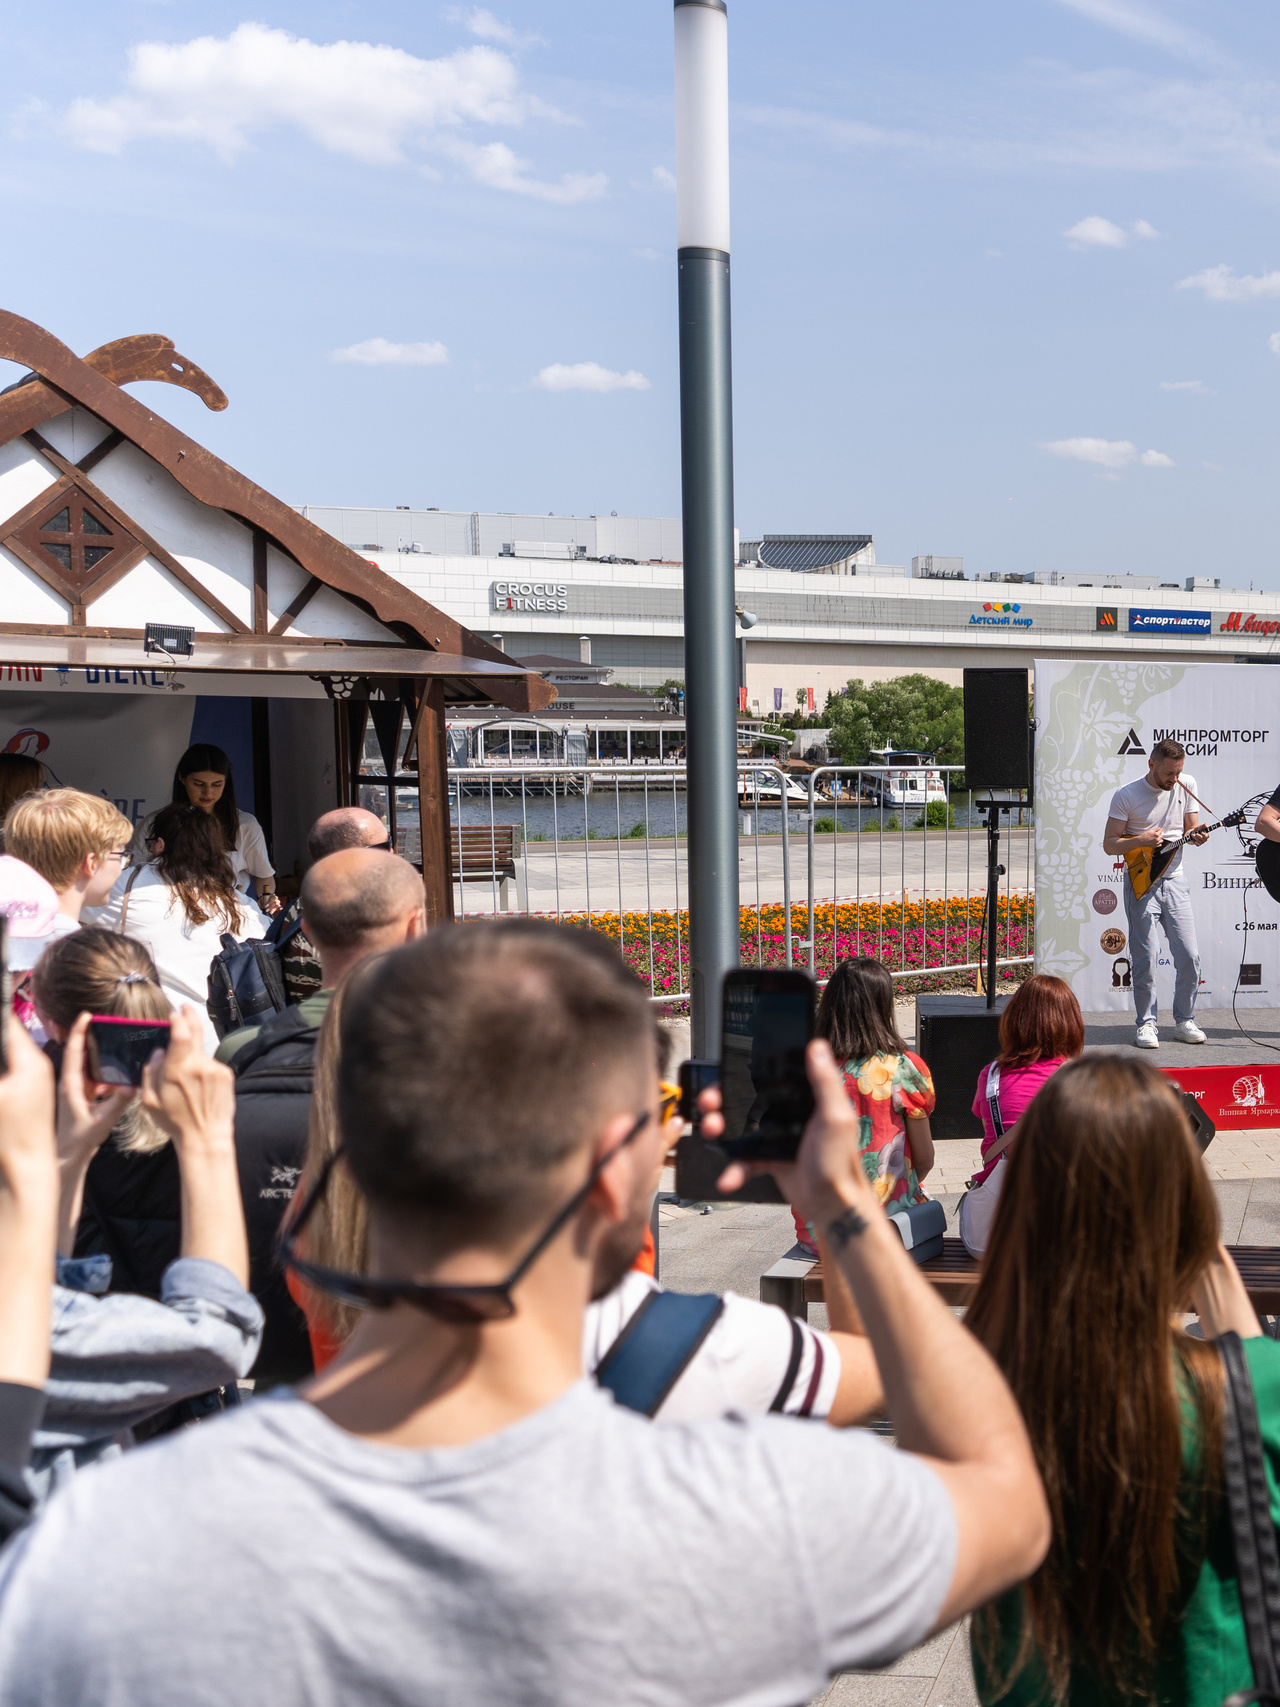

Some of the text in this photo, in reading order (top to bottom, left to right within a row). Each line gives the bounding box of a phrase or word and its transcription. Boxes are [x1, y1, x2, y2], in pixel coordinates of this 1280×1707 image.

[495, 582, 568, 597] CROCUS
[969, 614, 1033, 628] Детский мир
[1143, 616, 1211, 627] спортмастер
[1153, 728, 1270, 743] МИНПРОМТОРГ
[1202, 871, 1265, 889] Винна
[1242, 921, 1255, 931] 26
[1257, 923, 1278, 931] мая
[1218, 1108, 1248, 1116] Винная
